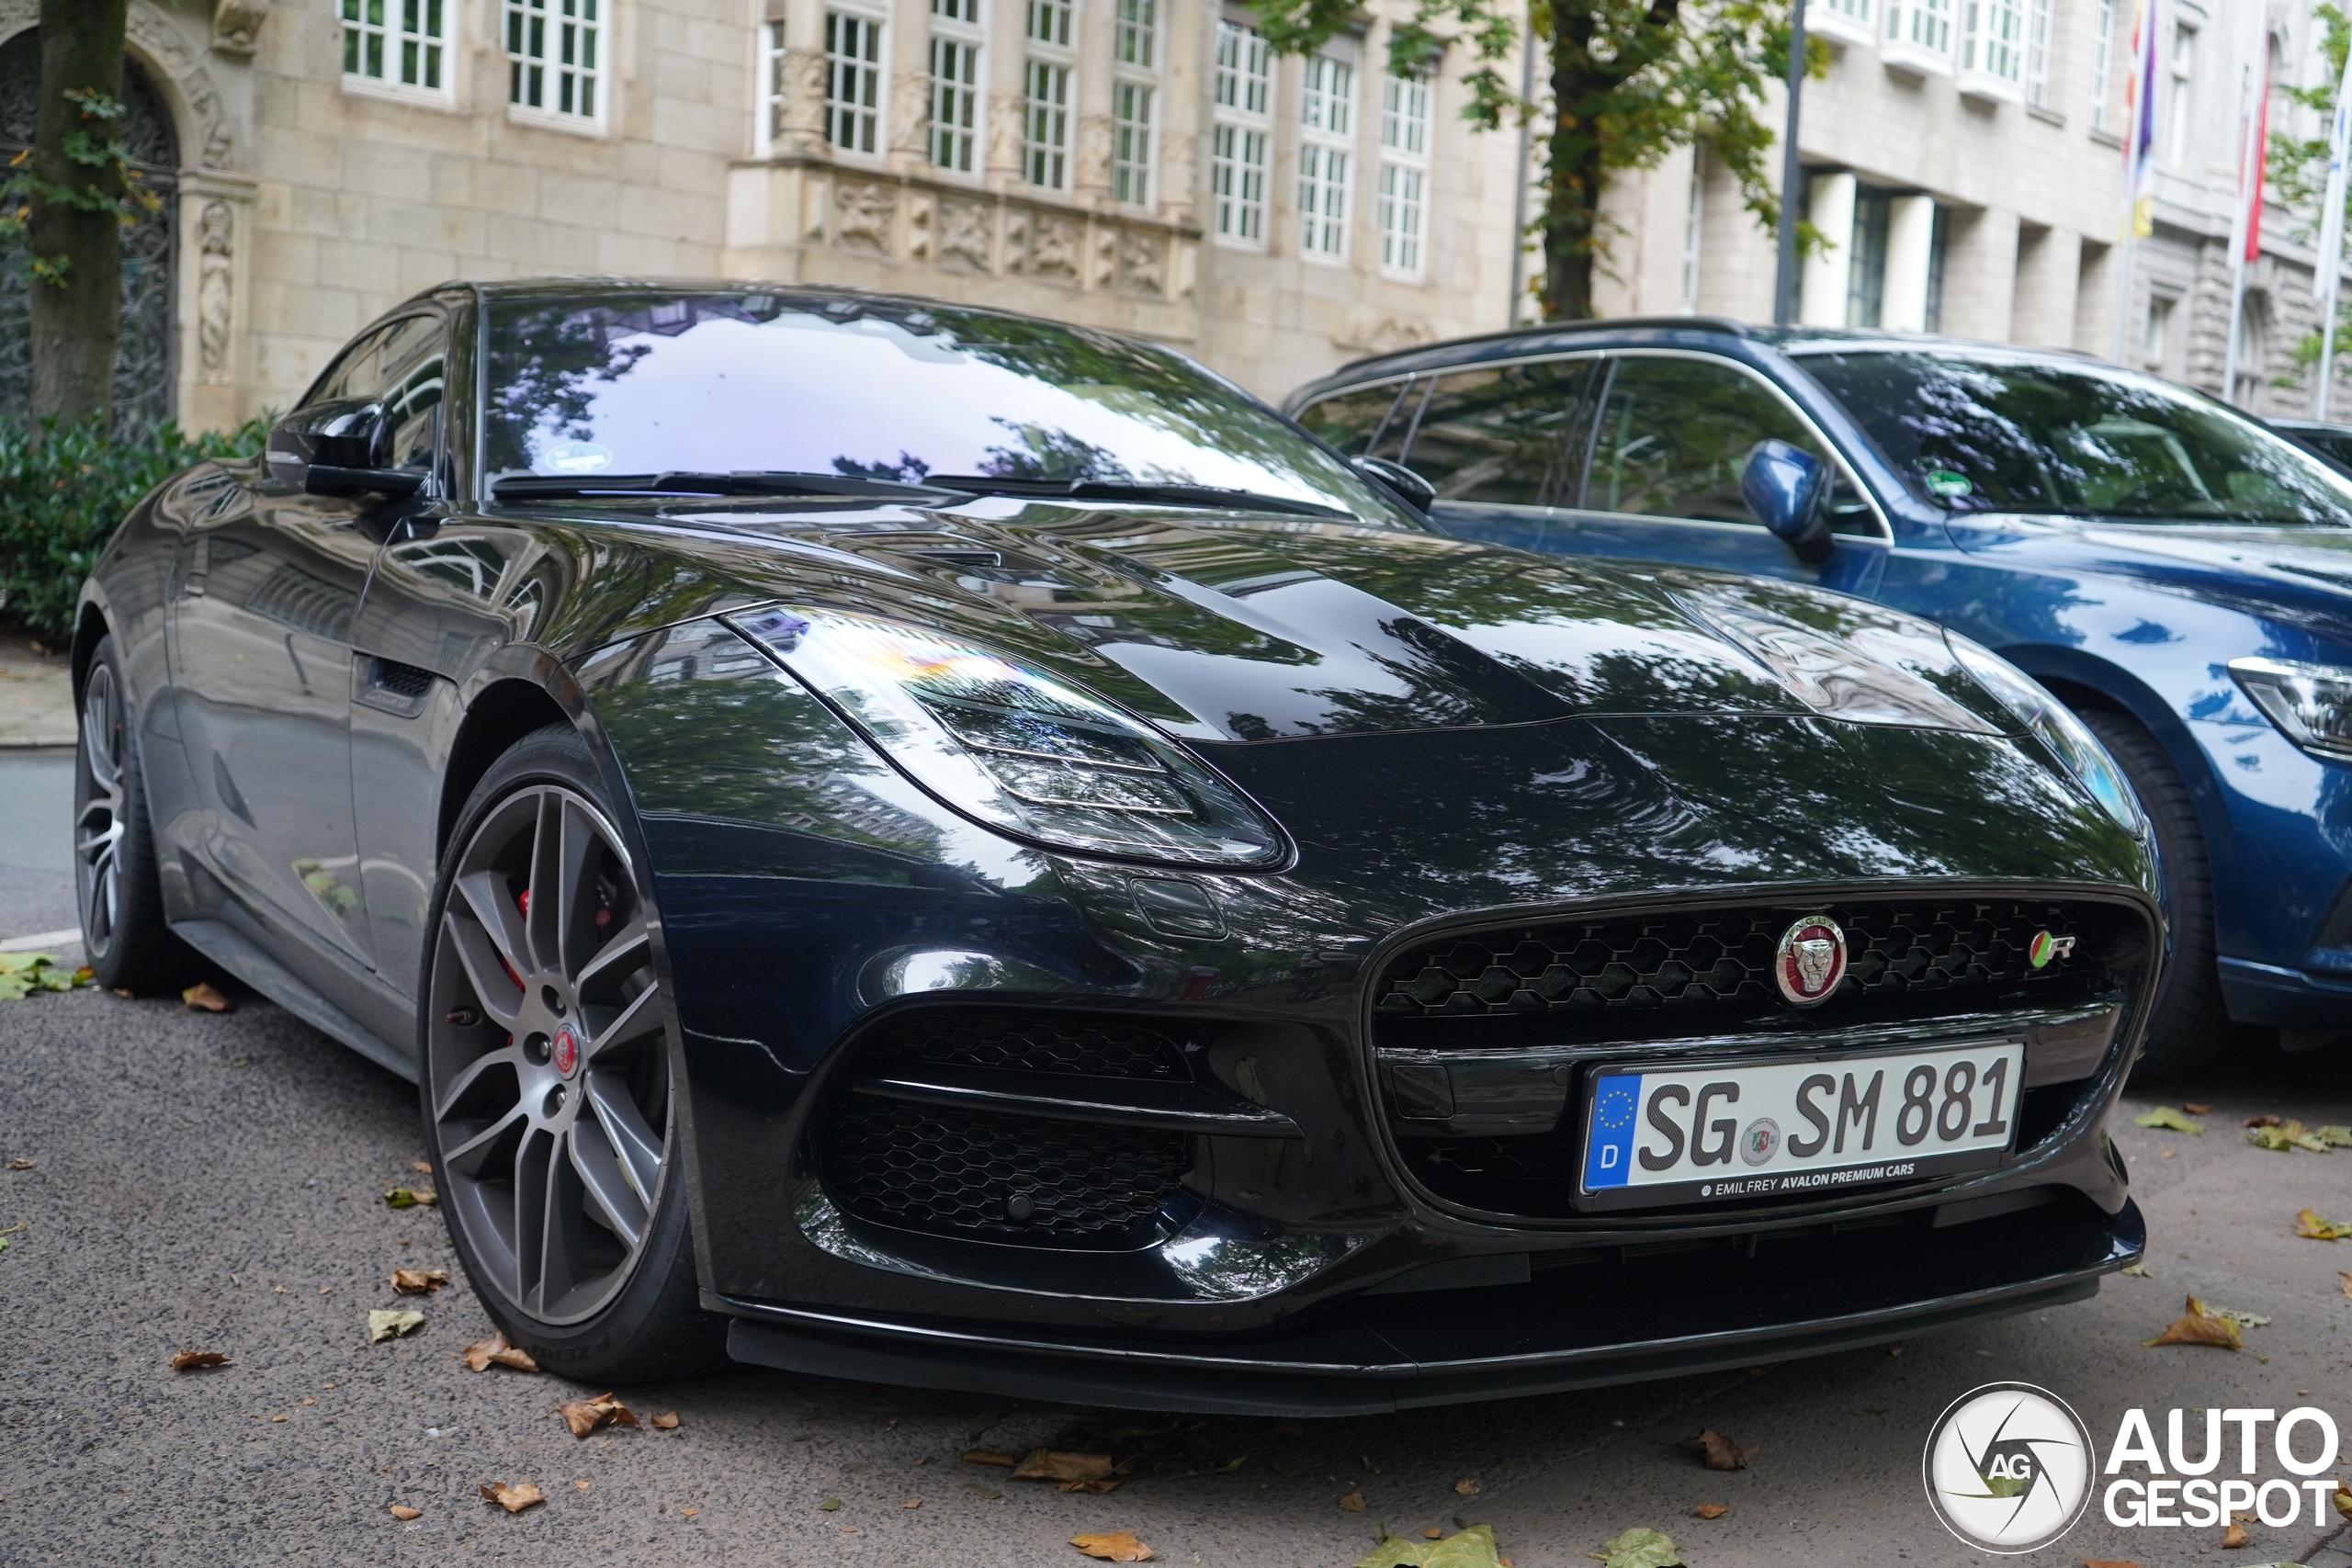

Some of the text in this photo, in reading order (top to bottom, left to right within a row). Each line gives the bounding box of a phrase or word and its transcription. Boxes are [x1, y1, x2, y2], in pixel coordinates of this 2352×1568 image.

[545, 746, 584, 761] OUTSIDE
[1787, 917, 1843, 942] JAGUAR
[2044, 936, 2075, 960] R
[1638, 1057, 2009, 1171] SG SM 881
[1600, 1145, 1619, 1169] D
[1715, 1163, 1915, 1196] EMIL FREY AVALON PREMIUM CARS
